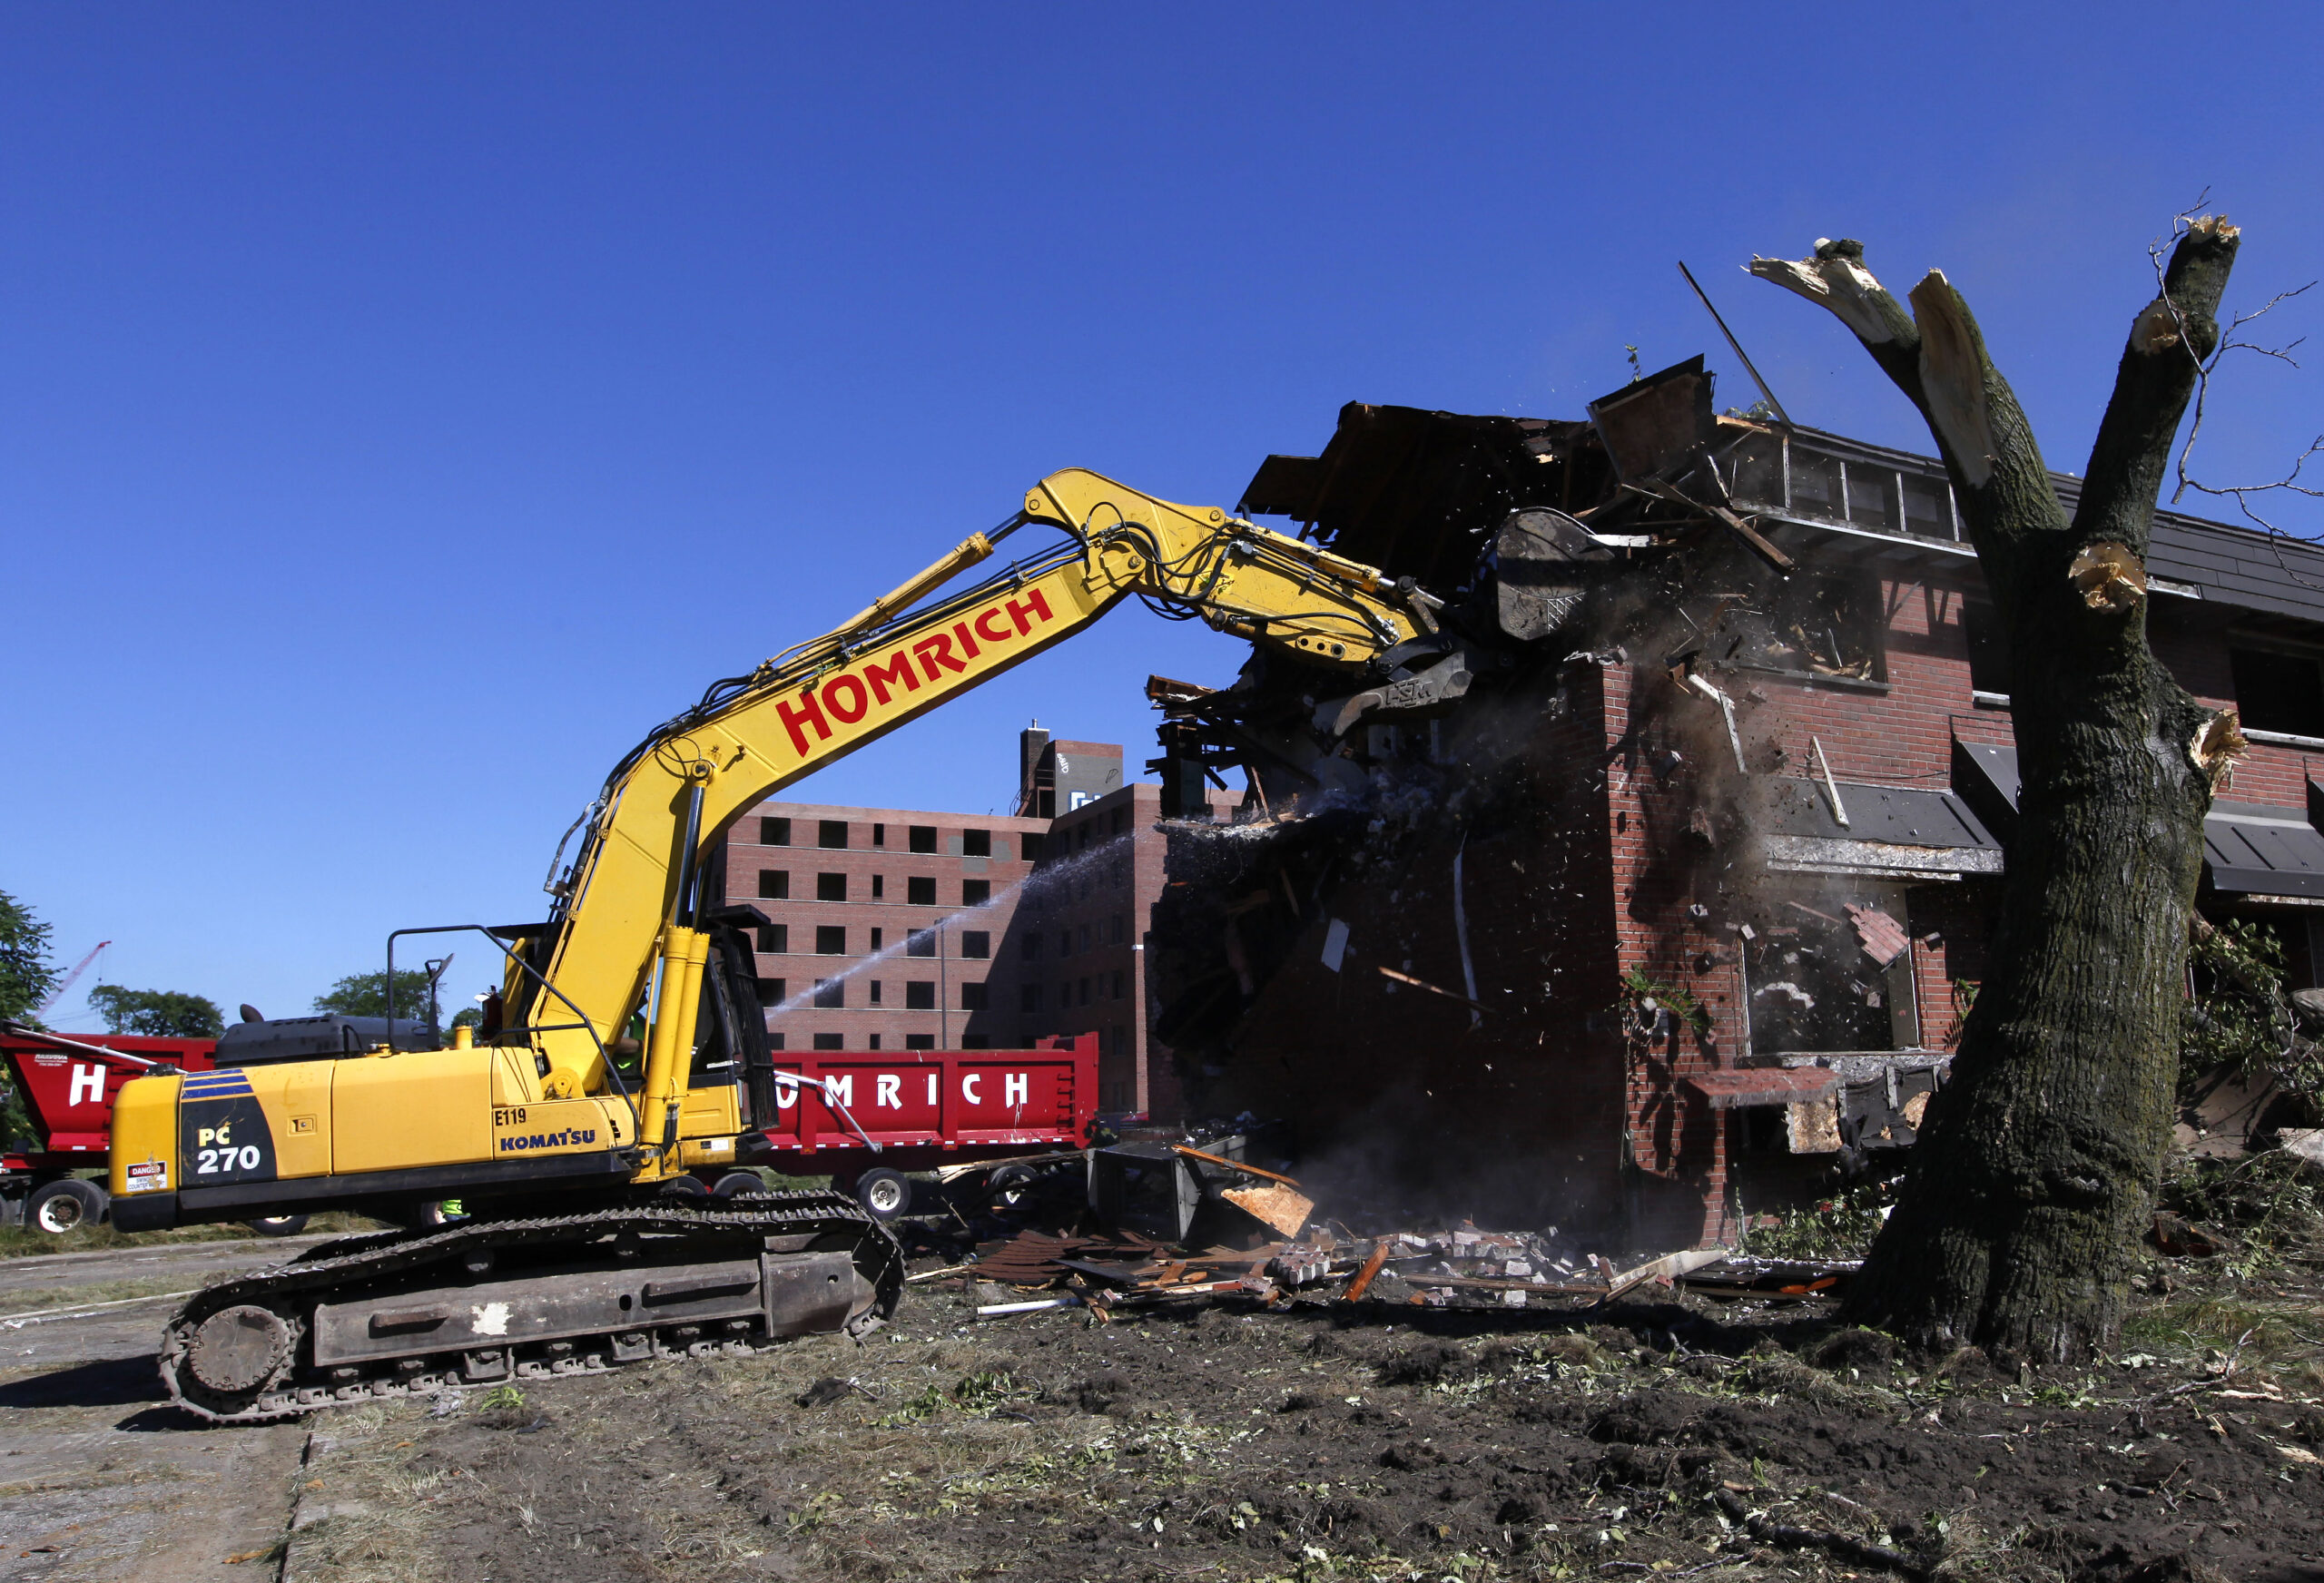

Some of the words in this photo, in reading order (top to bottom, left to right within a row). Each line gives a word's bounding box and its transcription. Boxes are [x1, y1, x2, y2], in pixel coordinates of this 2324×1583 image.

[775, 588, 1054, 758] HOMRICH
[69, 1064, 106, 1106] H
[495, 1108, 527, 1126] E119
[198, 1126, 231, 1147] PC
[500, 1127, 596, 1151] KOMATSU
[197, 1145, 261, 1175] 270
